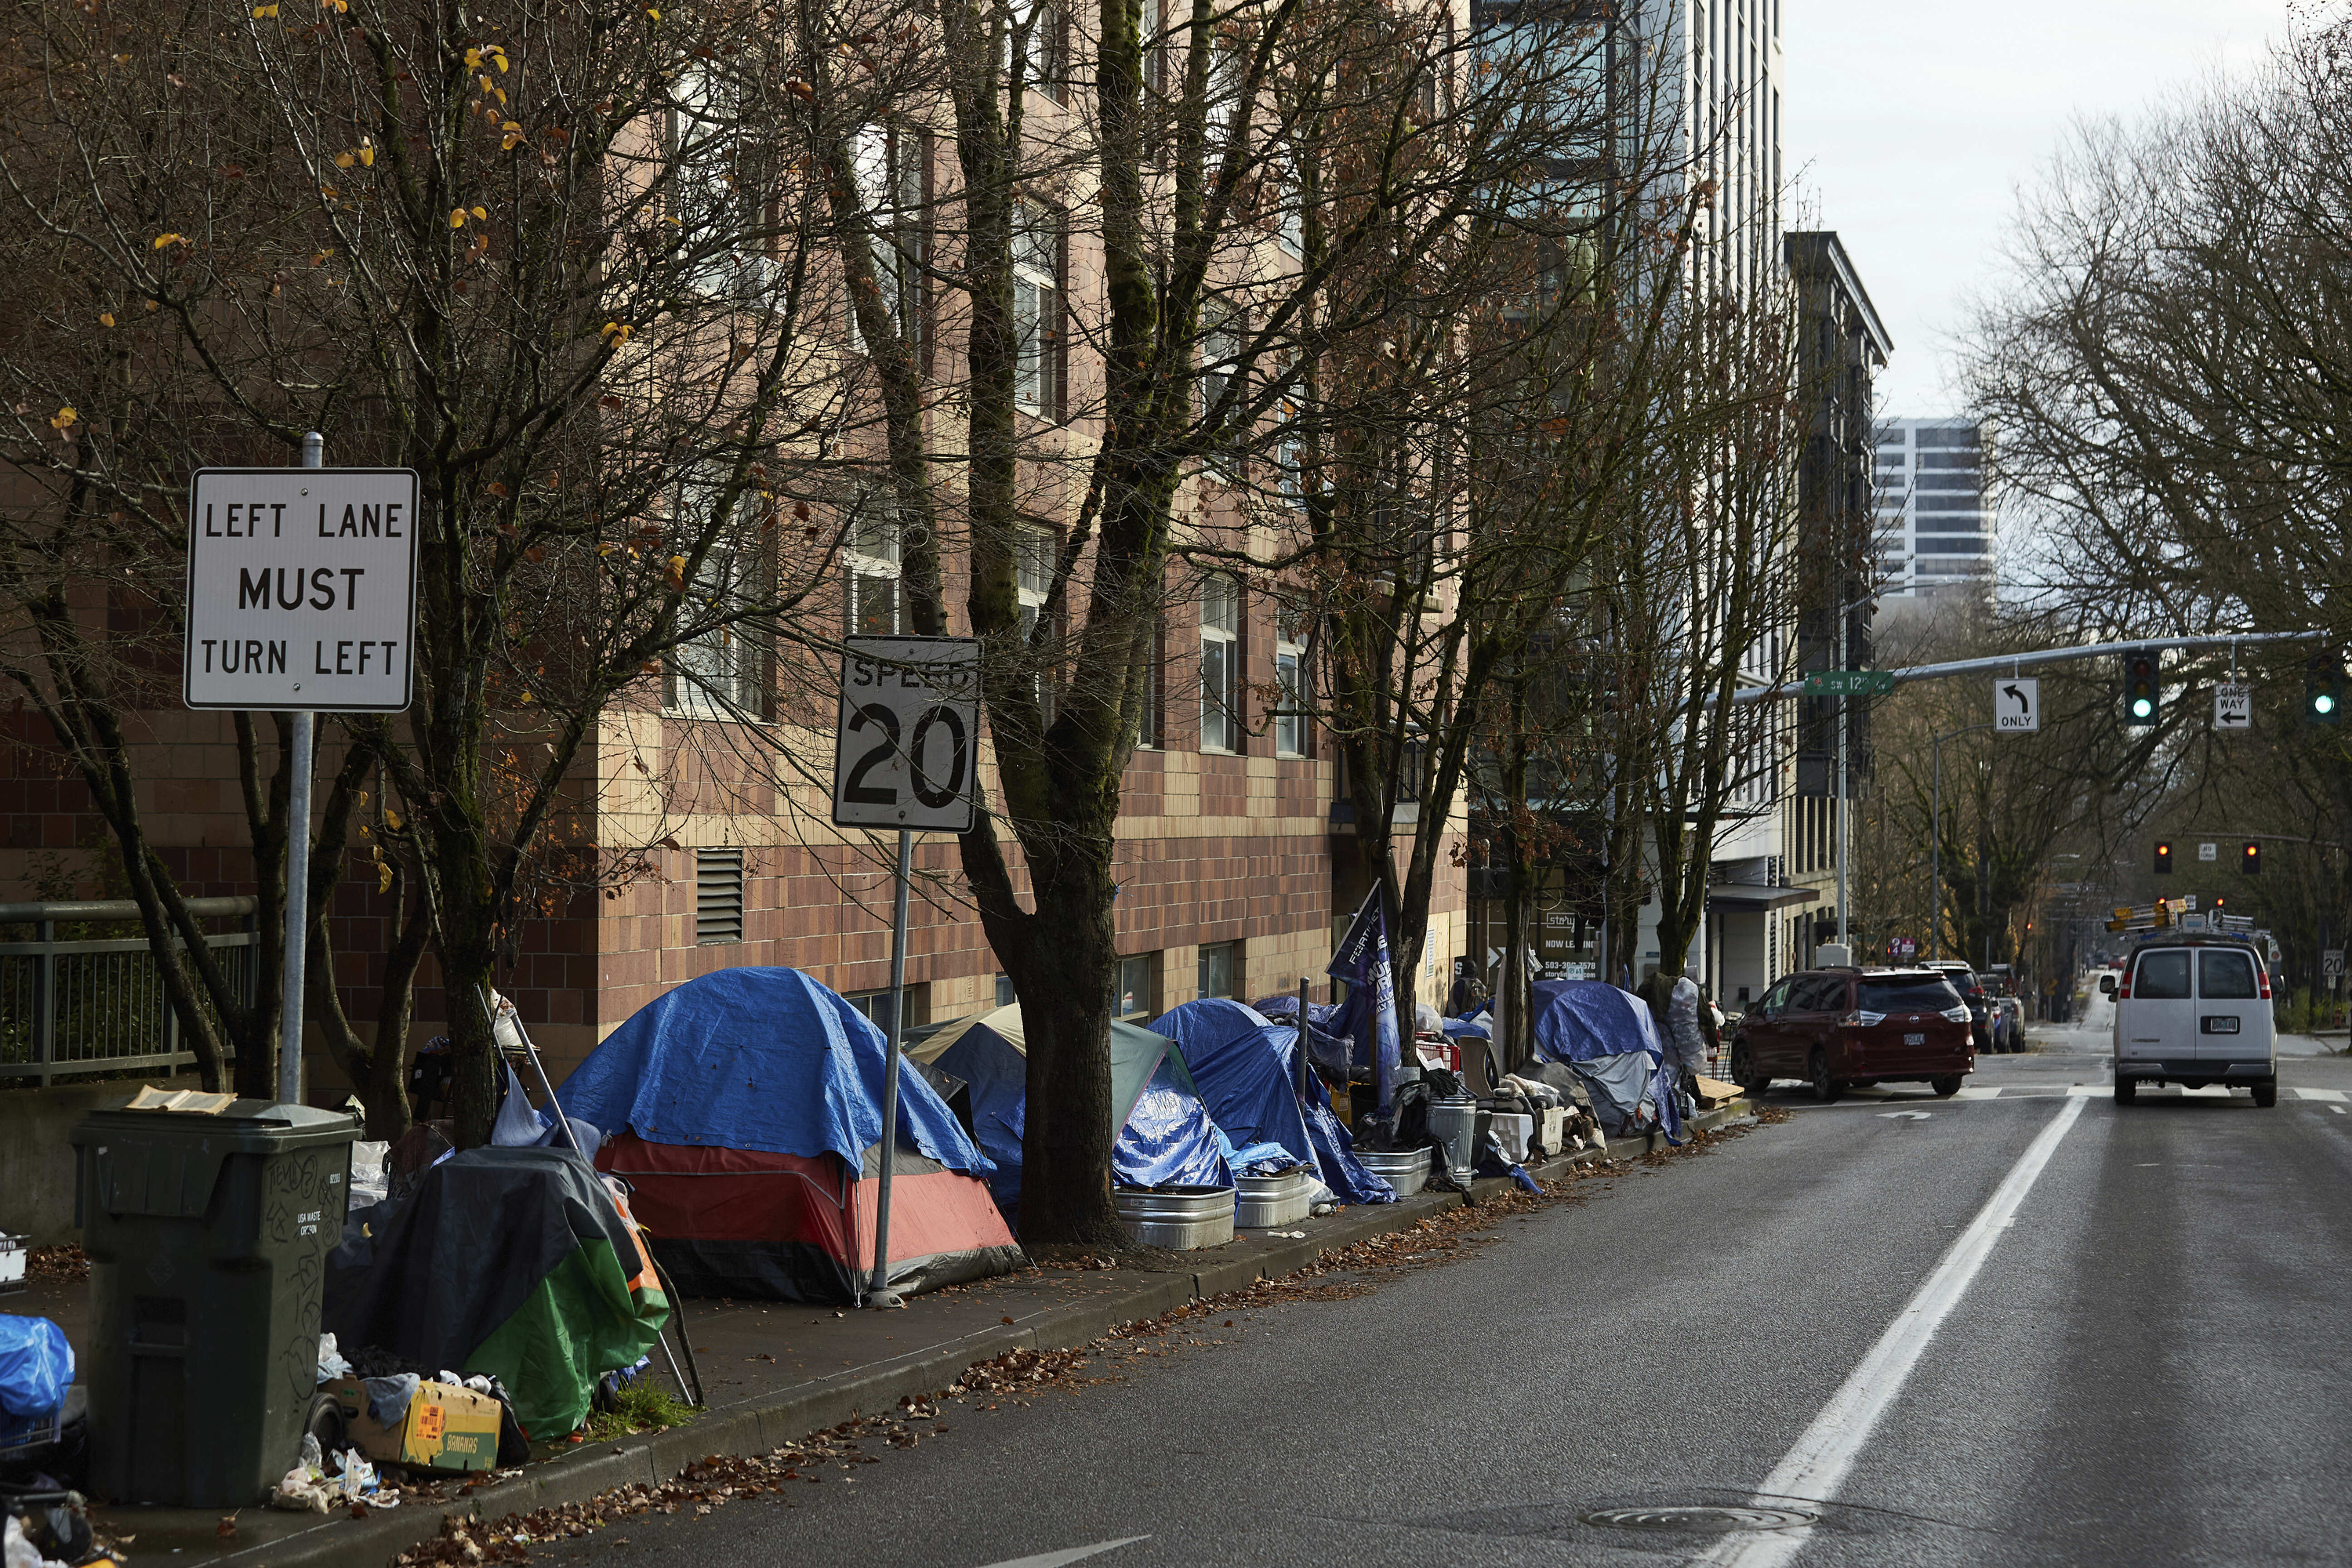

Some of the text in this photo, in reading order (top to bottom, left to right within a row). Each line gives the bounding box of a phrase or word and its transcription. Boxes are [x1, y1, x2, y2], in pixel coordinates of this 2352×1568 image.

[206, 504, 402, 537] LEFT LANE
[238, 568, 365, 610] MUST
[201, 640, 397, 675] TURN LEFT
[1831, 681, 1843, 690] SW
[2221, 688, 2244, 698] ONE
[2220, 699, 2245, 710] WAY
[2002, 715, 2031, 727] ONLY
[844, 702, 967, 808] 20
[1565, 940, 1594, 949] LEIN
[2325, 958, 2343, 974] 20
[298, 1210, 321, 1223] USA WASTE
[447, 1434, 478, 1454] BANANAS
